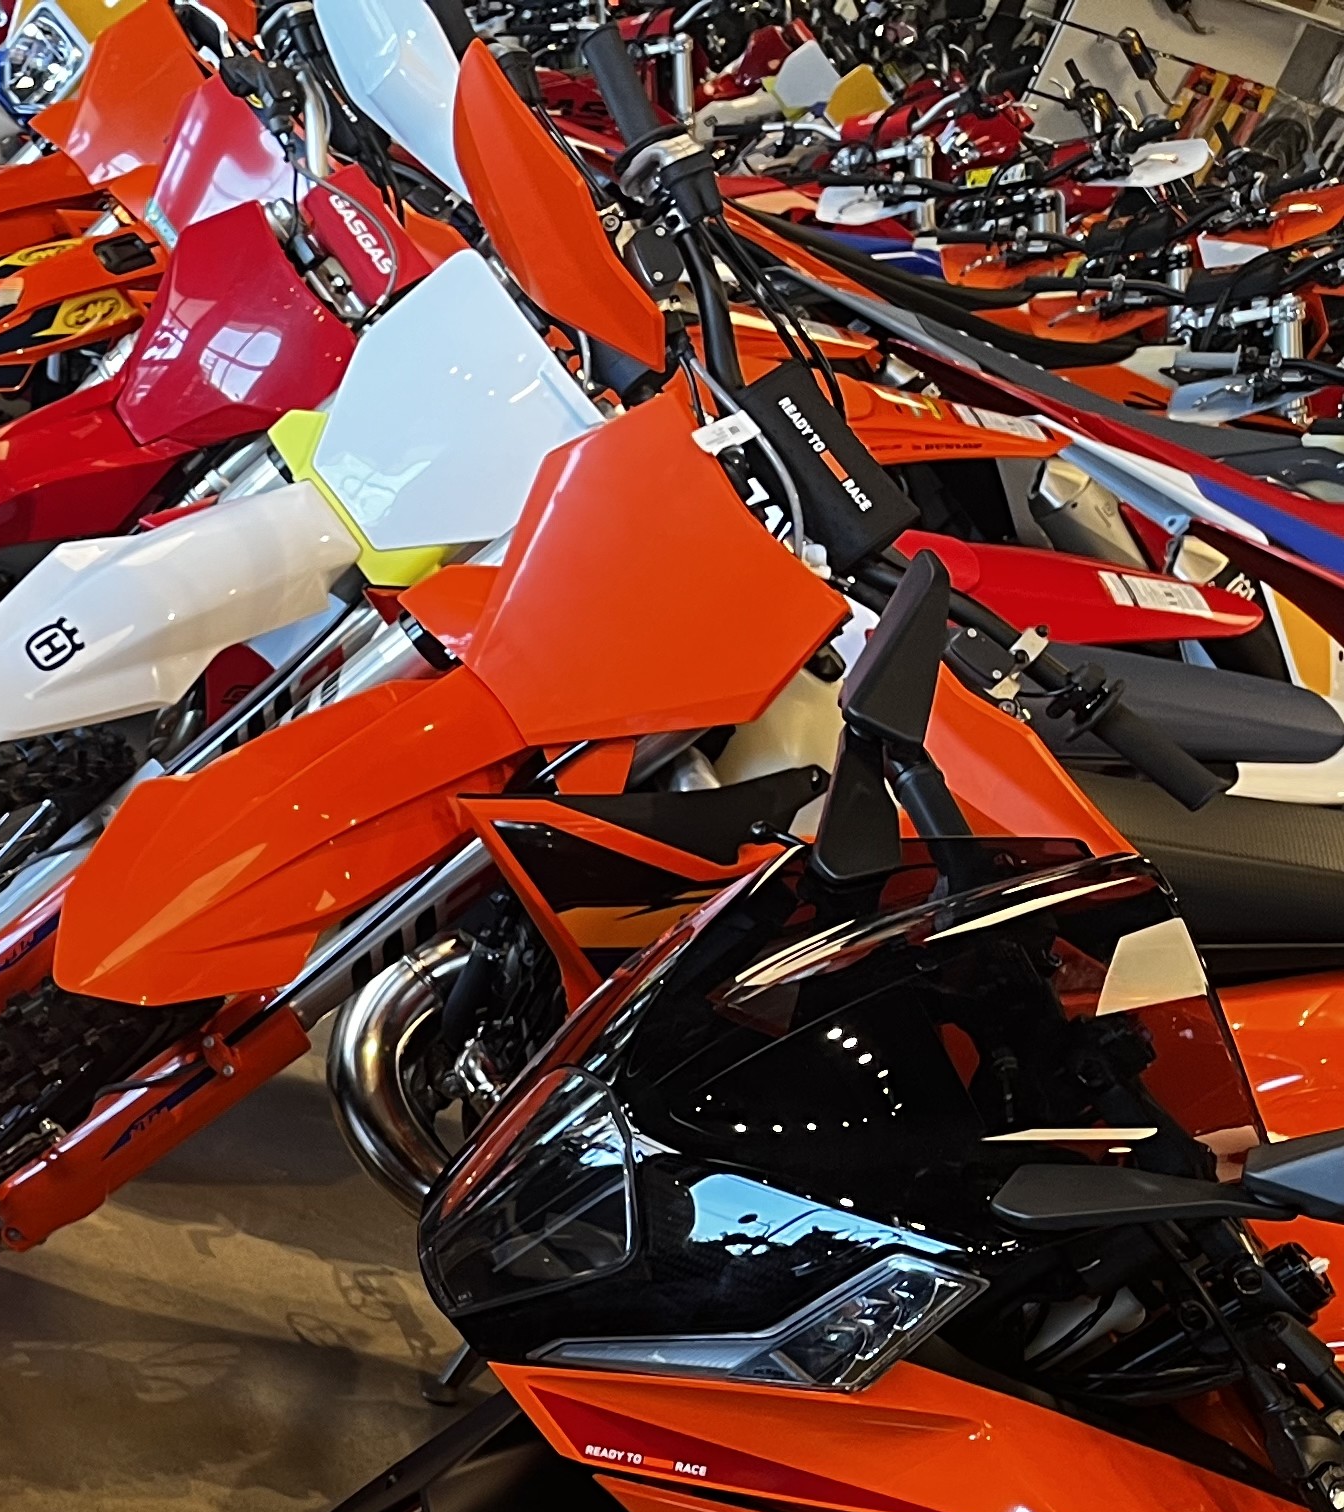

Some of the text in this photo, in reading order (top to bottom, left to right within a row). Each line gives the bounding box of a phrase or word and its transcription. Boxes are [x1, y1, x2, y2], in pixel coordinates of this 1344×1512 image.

[329, 194, 394, 275] GASGAS
[778, 396, 873, 513] READY TO RACE
[585, 1445, 707, 1476] READY TO RACE
